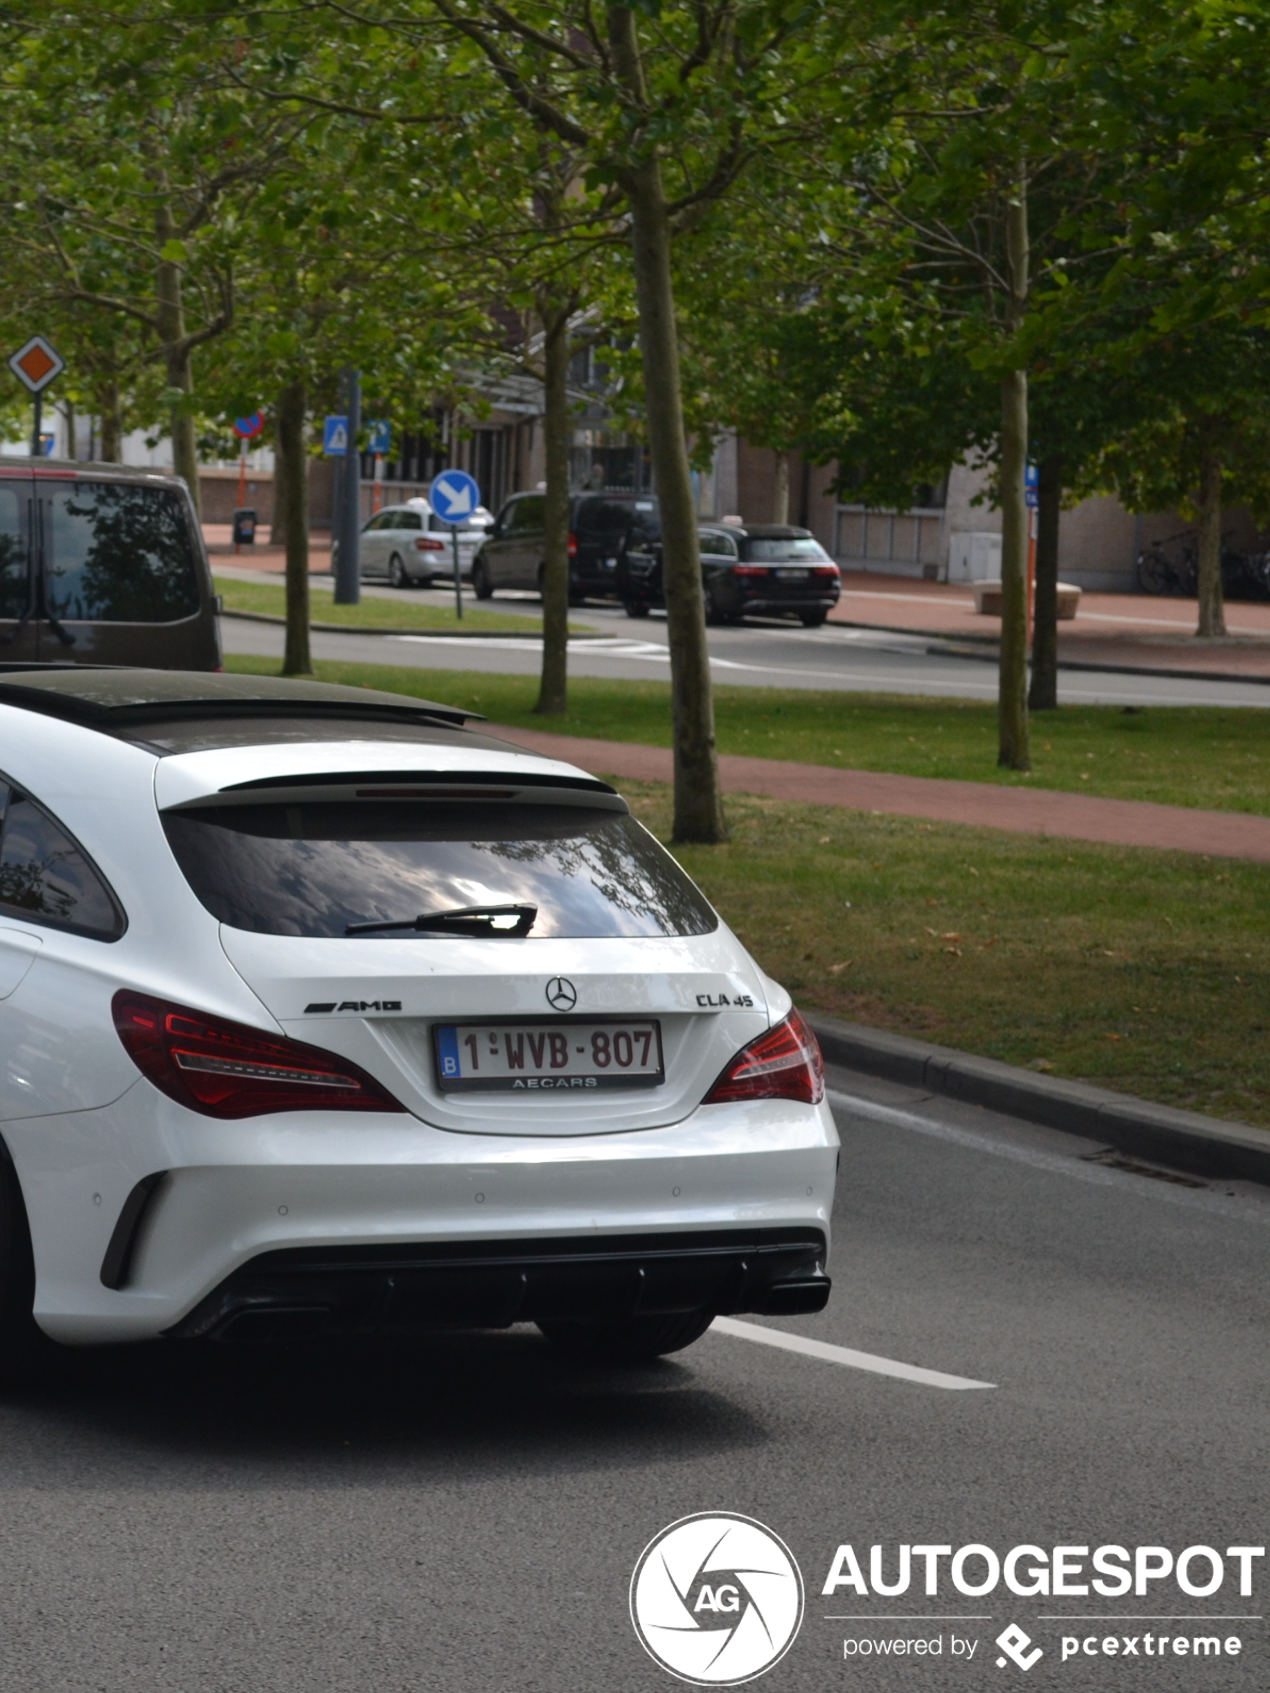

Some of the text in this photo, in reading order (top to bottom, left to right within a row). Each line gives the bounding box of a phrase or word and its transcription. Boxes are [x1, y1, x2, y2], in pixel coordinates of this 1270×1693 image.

[338, 1001, 402, 1012] AMG
[696, 994, 754, 1007] CLA 45
[444, 1057, 457, 1074] B
[512, 1077, 598, 1088] AECARS
